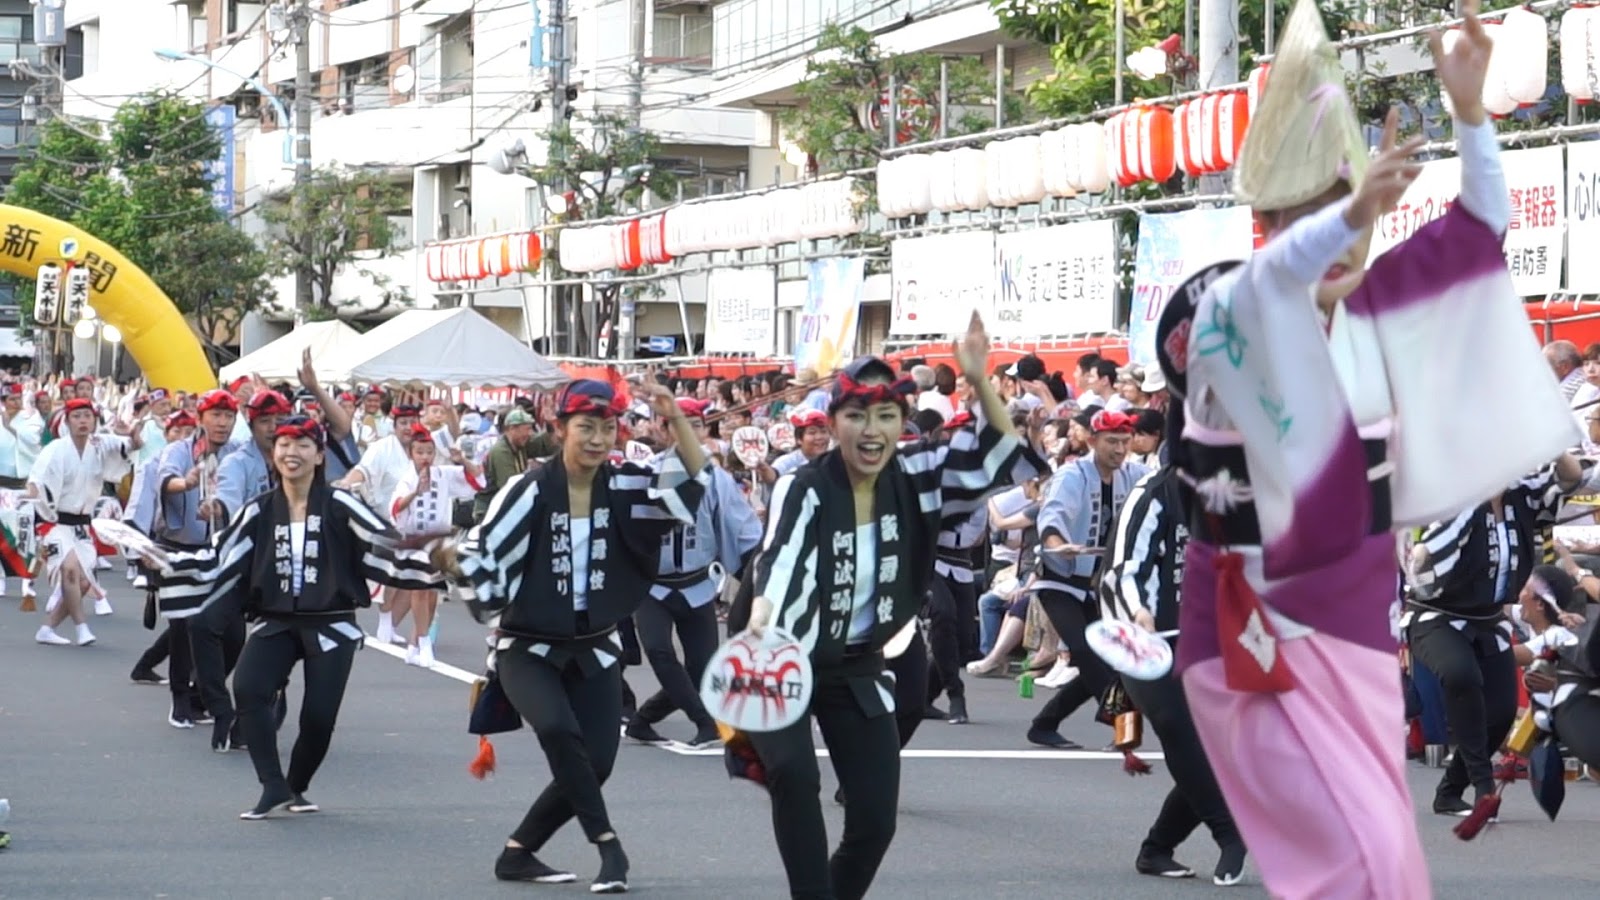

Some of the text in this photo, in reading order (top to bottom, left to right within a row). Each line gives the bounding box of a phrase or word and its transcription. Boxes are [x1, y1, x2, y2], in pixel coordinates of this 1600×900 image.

[0, 224, 117, 294] 新聞
[274, 524, 292, 593] 阿波踊り
[550, 511, 571, 596] 阿波踊り
[829, 530, 854, 640] 阿波踊り
